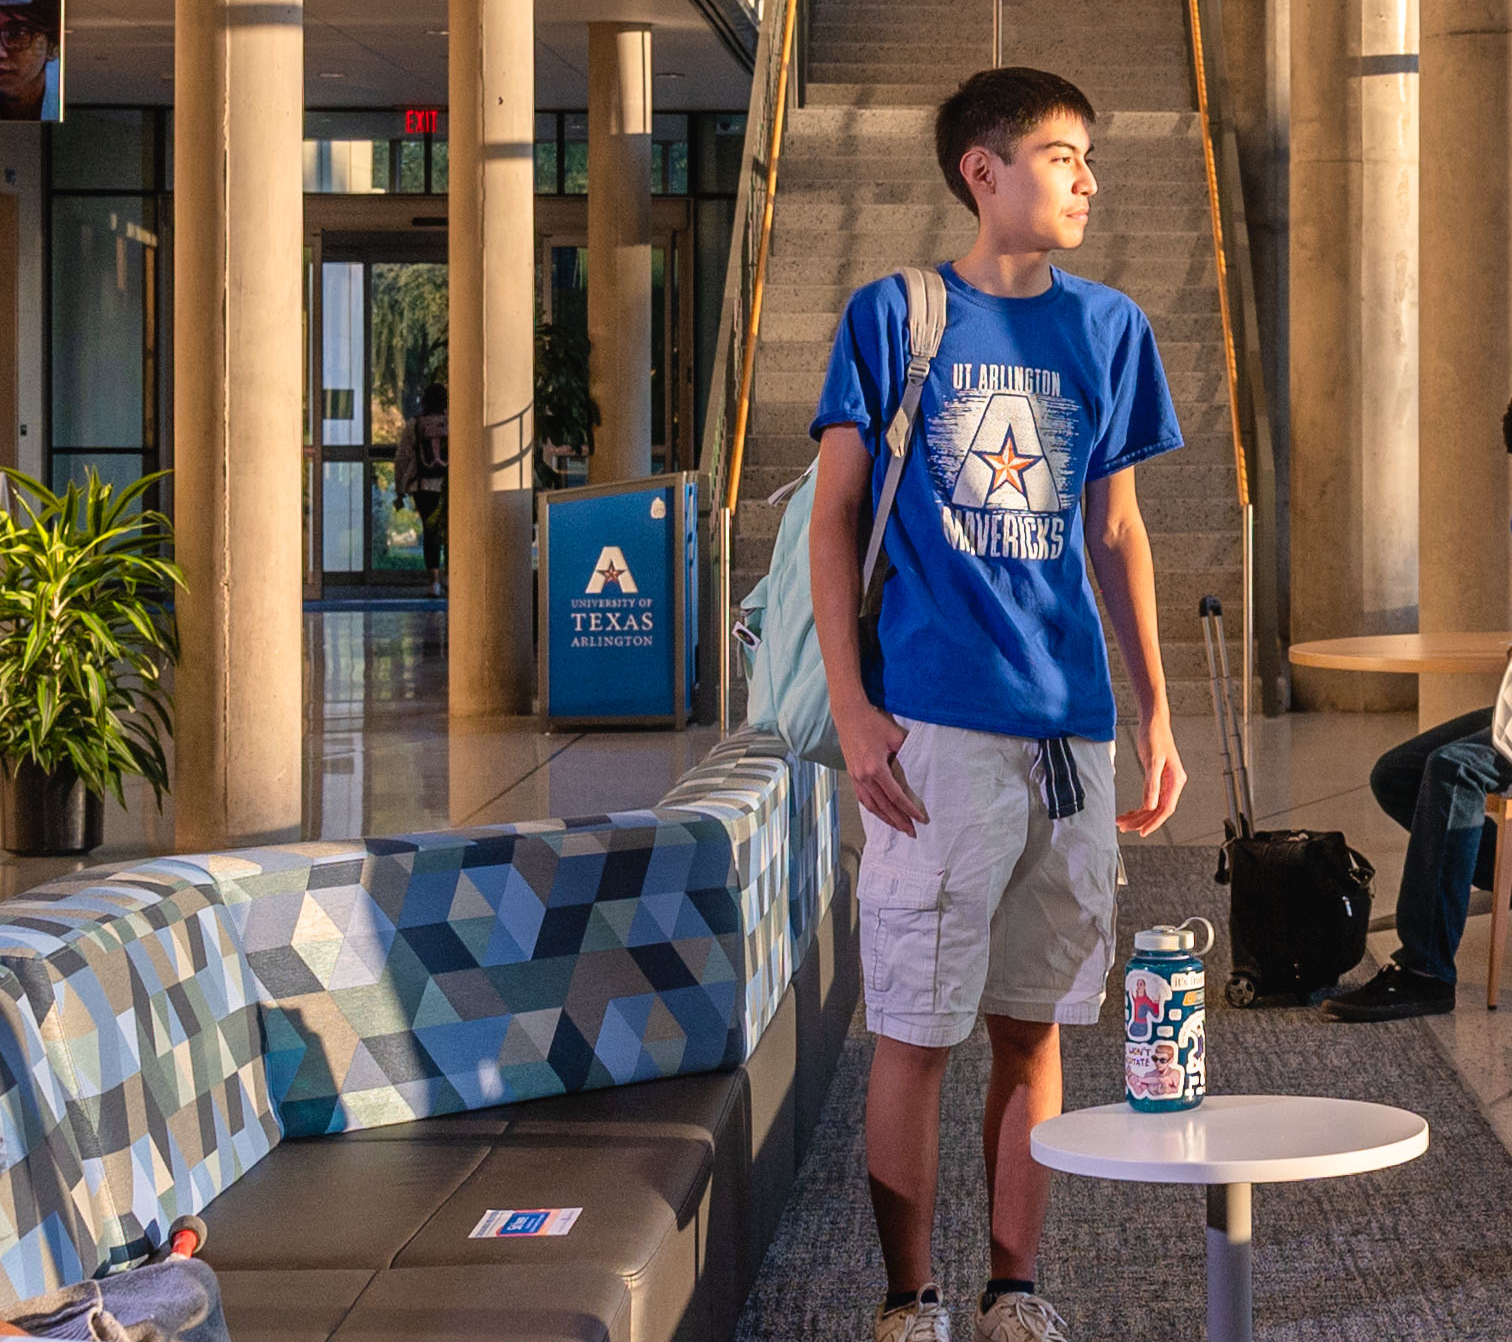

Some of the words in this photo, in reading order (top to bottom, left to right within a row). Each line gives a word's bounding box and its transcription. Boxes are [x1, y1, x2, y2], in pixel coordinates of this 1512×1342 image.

[405, 109, 439, 133] EXIT
[952, 363, 973, 391] UT
[978, 363, 1061, 397] ARLINGTON
[942, 506, 1065, 560] MAVERICKS
[571, 598, 636, 609] UNIVERSITY
[638, 598, 653, 608] OF
[571, 612, 654, 632] TEXAS
[571, 636, 653, 648] ARLINGTON
